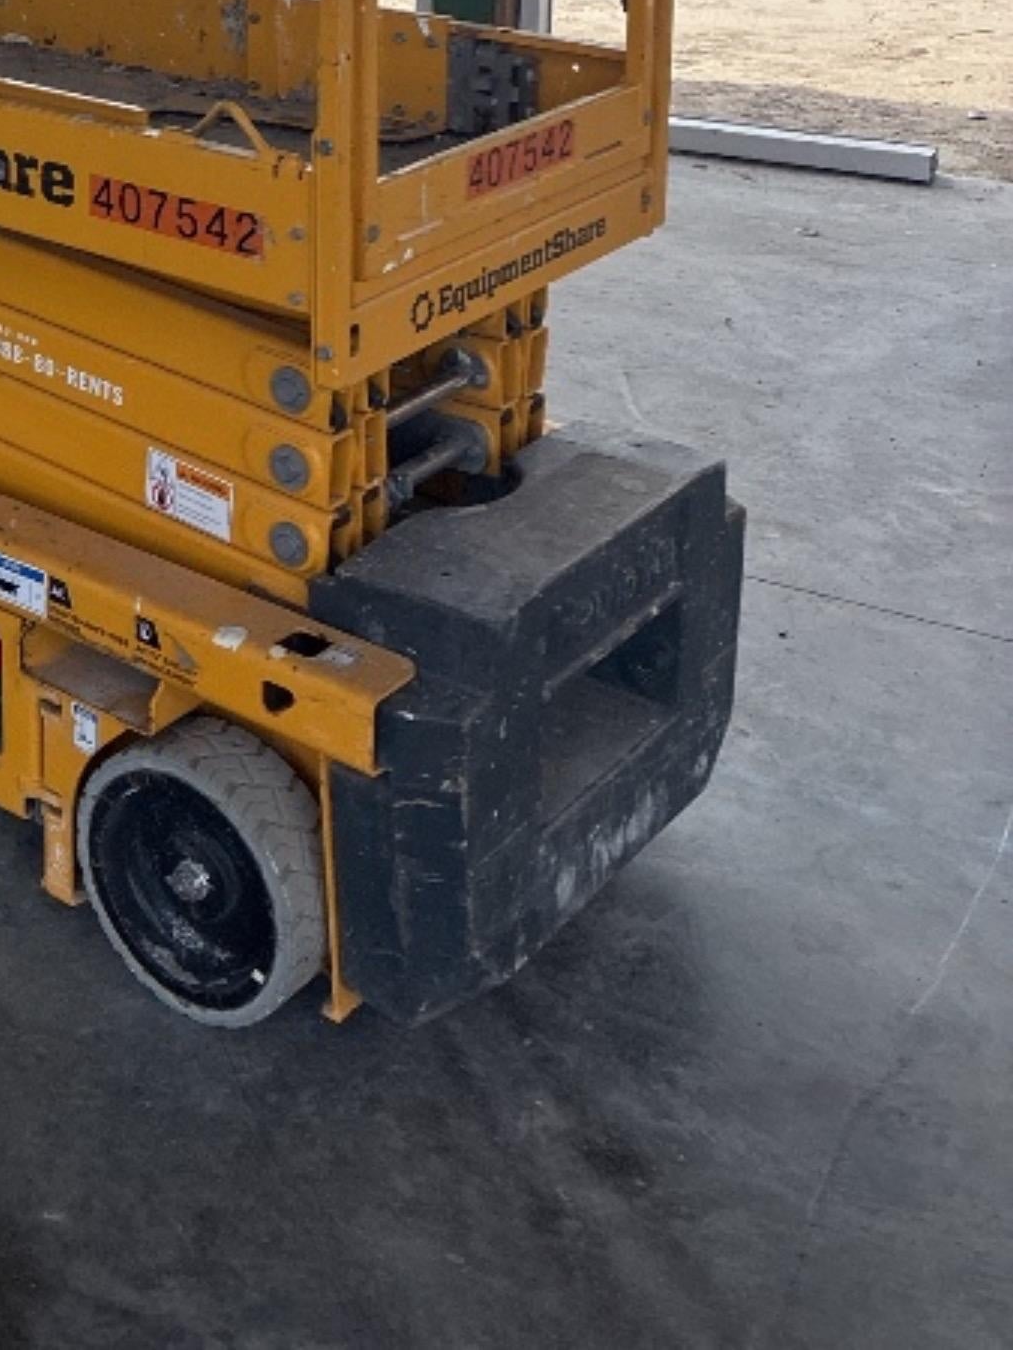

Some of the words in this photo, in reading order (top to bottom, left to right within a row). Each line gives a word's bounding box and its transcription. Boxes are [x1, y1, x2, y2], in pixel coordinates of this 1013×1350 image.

[468, 120, 574, 194] 407542
[92, 179, 259, 256] 407542
[438, 216, 607, 316] EquipmentShare
